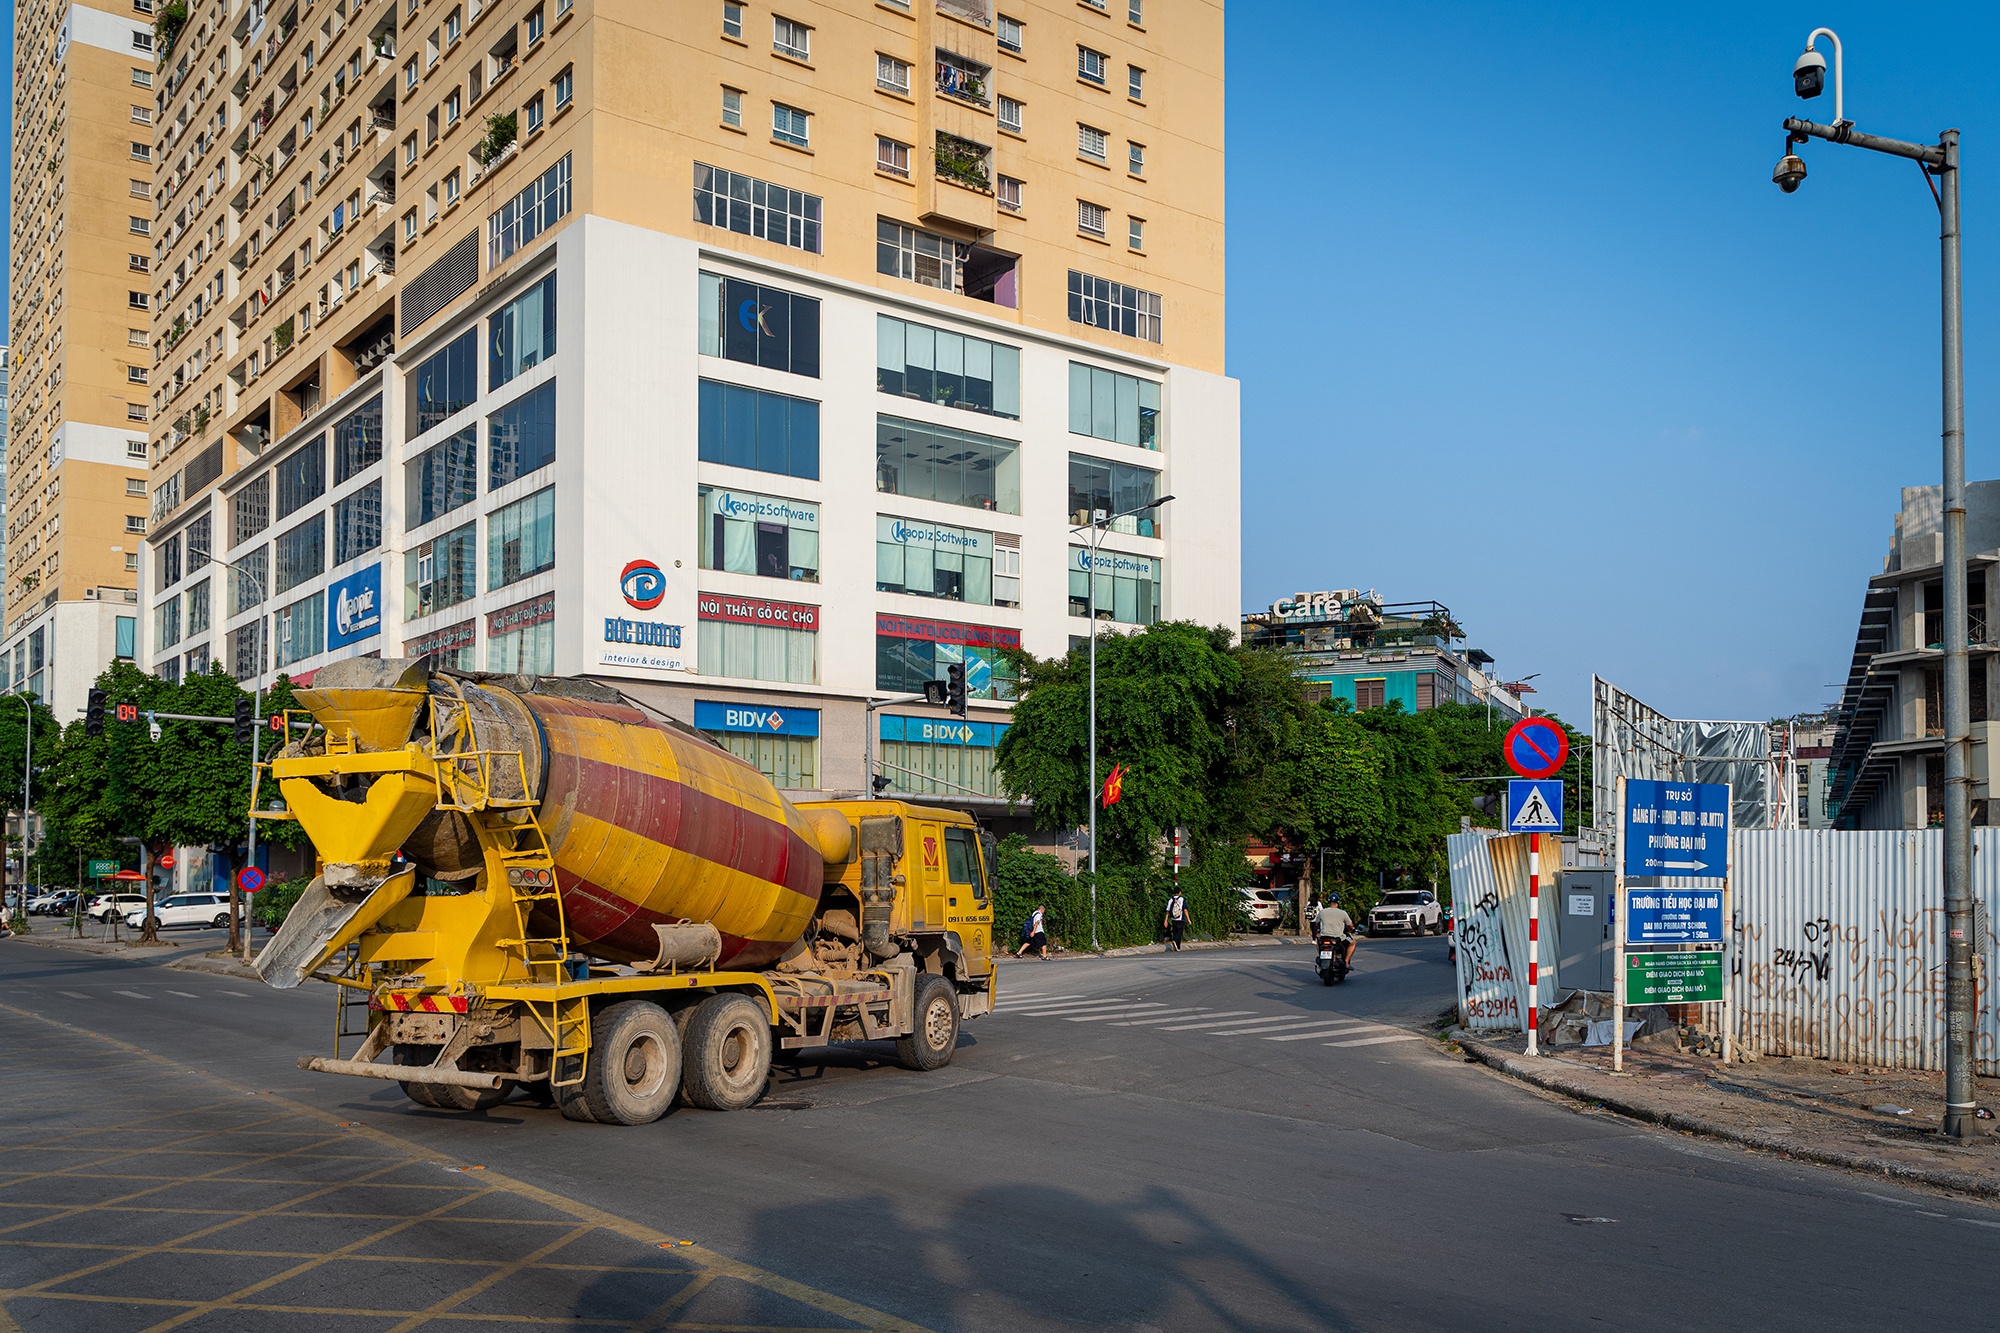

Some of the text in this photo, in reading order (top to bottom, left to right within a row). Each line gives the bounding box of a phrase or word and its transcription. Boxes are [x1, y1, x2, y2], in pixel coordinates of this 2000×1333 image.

[766, 503, 815, 522] Software
[936, 530, 978, 548] Software
[1112, 557, 1149, 573] Software
[700, 599, 814, 624] NỘI THẤT GỖ ÓC CHÓ
[877, 618, 1018, 645] NOITHATDUCDUONG.COM
[604, 653, 681, 668] interior & design
[119, 704, 138, 721] 04
[726, 710, 767, 728] BIDV
[922, 723, 957, 740] BIDV
[1665, 788, 1692, 804] TRỤ SỞ
[1632, 803, 1649, 824] ĐẢNG
[1648, 833, 1706, 853] PHƯỜNG ĐẠI MỖ
[1645, 859, 1663, 867] 200m
[1632, 894, 1660, 909] TRƯỜNG
[1661, 893, 1677, 909] TIỂU
[1678, 897, 1692, 911] HỌC
[1693, 897, 1706, 911] ĐẠI
[1663, 922, 1686, 930] PRIMARY
[1687, 921, 1707, 930] SCHOOL
[1691, 931, 1709, 939] 150m
[1658, 970, 1672, 978] GIAO
[1467, 995, 1519, 1019] 862914
